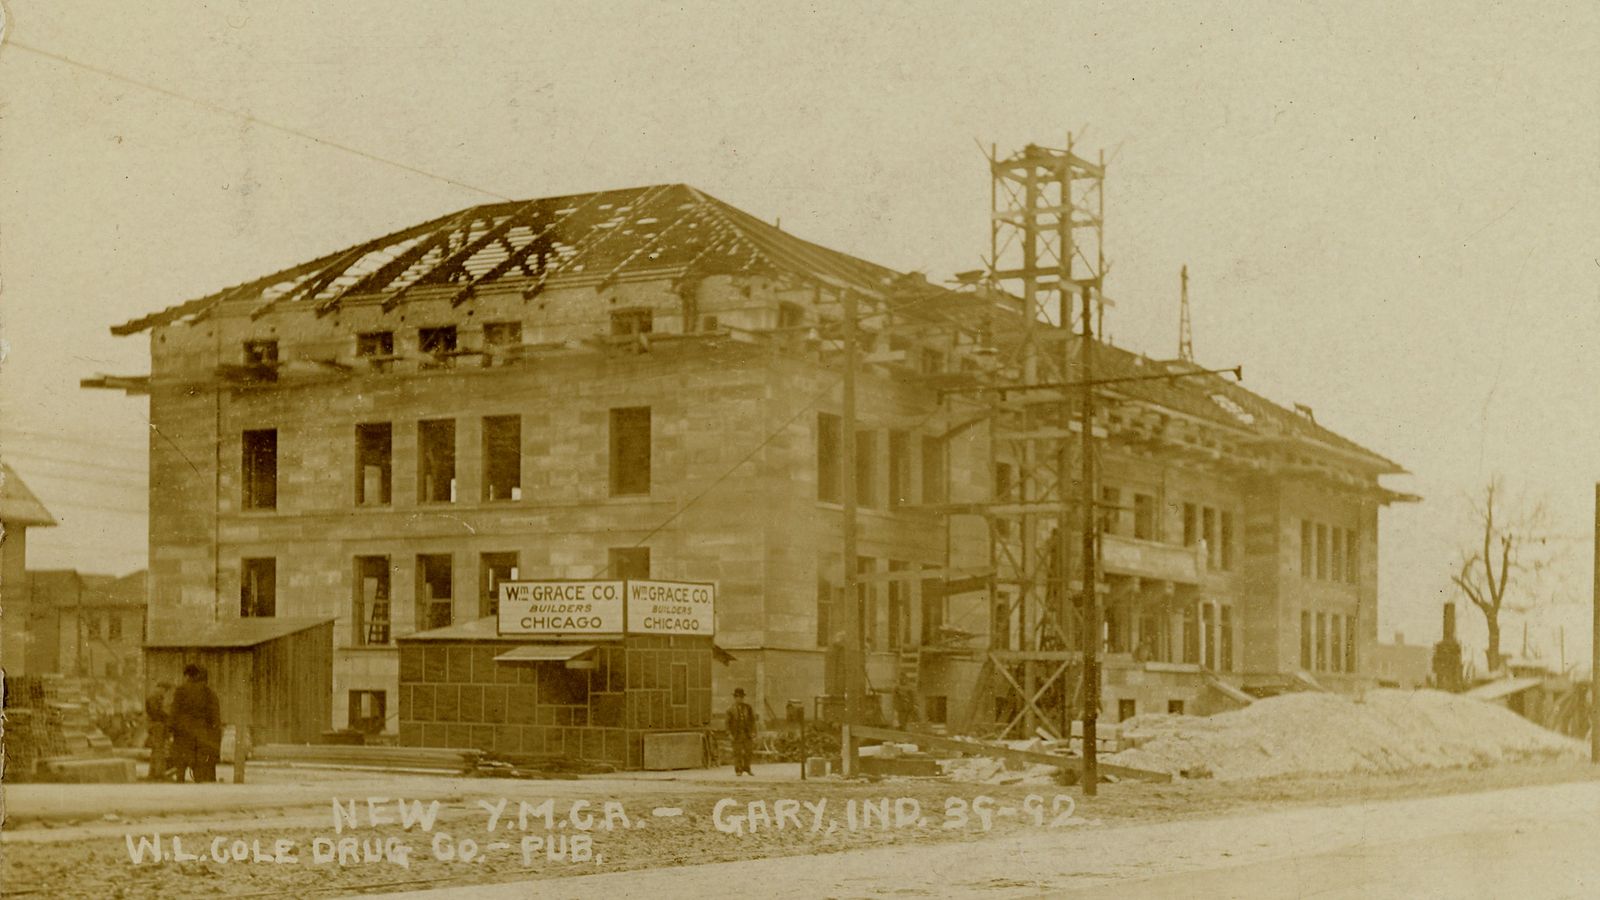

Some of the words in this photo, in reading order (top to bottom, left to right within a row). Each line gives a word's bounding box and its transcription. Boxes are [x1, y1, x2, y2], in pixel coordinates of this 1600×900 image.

[532, 585, 585, 601] GRACE
[592, 585, 619, 600] CO.
[649, 586, 689, 602] GRACE
[692, 588, 711, 604] CO.
[529, 603, 592, 613] BUILDERS
[652, 605, 692, 616] BUILDERS
[520, 616, 602, 629] CHICAGO
[643, 616, 700, 631] CHICAGO
